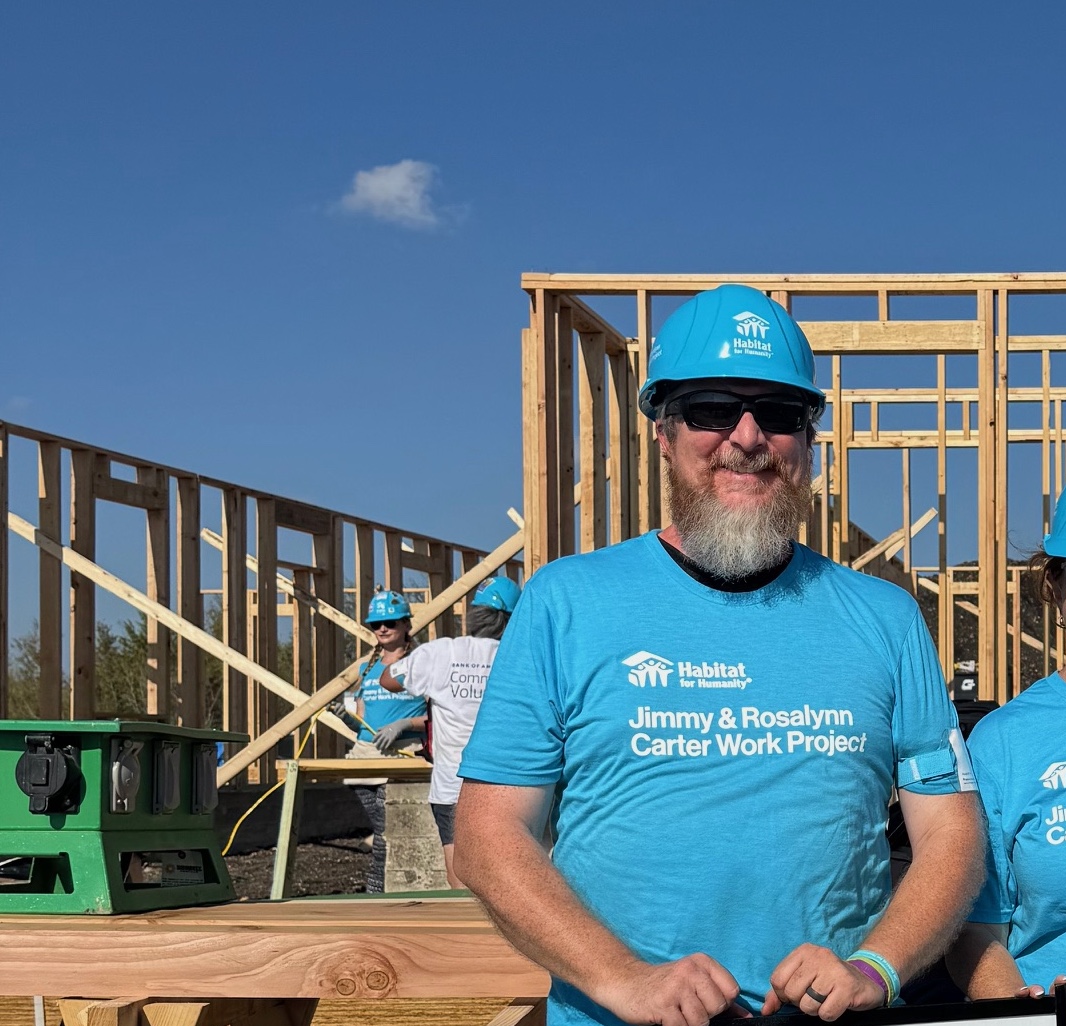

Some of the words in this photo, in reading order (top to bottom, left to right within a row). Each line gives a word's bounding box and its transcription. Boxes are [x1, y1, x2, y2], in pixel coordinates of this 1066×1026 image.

[733, 338, 772, 352] Habitat
[744, 348, 772, 359] Humanity
[678, 661, 747, 679] Habitat
[680, 678, 694, 688] for
[698, 678, 748, 690] Humanity
[629, 705, 714, 734] Jimmy
[718, 707, 737, 729] &
[741, 704, 854, 730] Rosalynn
[631, 733, 712, 757] Carter
[715, 733, 782, 756] Work
[787, 729, 867, 757] Project
